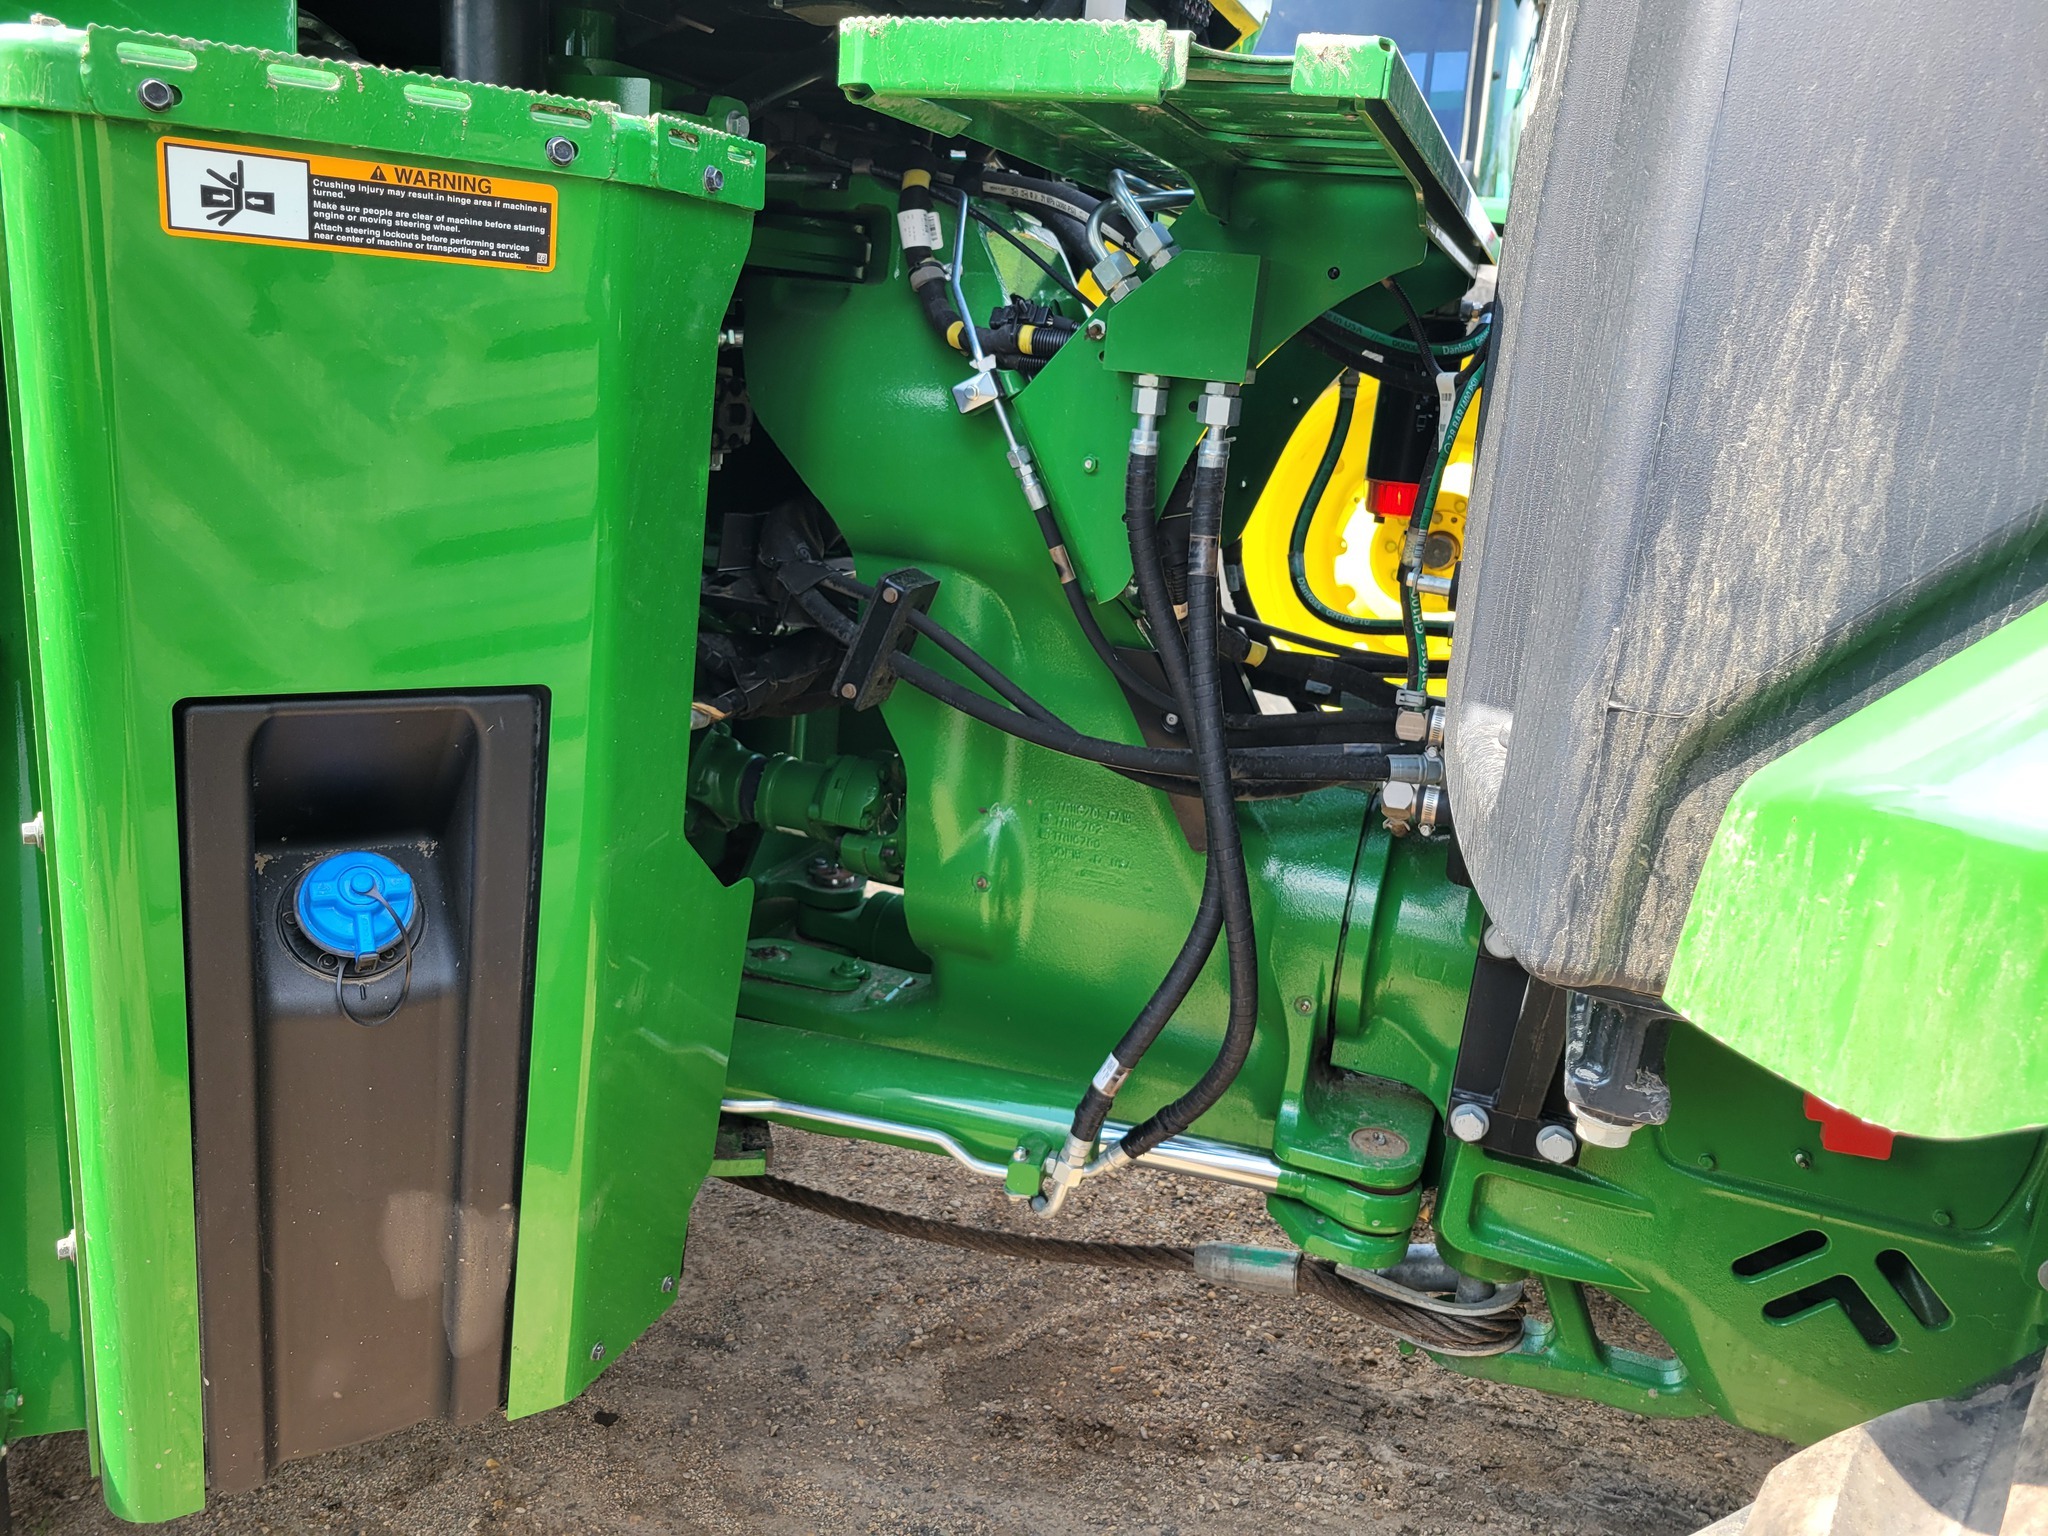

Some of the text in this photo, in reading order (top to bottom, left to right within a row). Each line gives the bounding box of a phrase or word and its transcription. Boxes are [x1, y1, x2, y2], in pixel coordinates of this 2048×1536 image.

[313, 188, 346, 199] turned.
[394, 167, 492, 194] WARNING
[313, 178, 547, 214] Crushing injury may result in hinge area if machine is
[313, 200, 546, 235] Make sure people are clear of machine before starting
[313, 210, 345, 220] engine
[359, 216, 393, 227] moving
[394, 219, 431, 231] steering
[433, 223, 461, 233] wheel.
[314, 222, 530, 252] Attach steering lockouts before performing services
[314, 232, 334, 240] near
[336, 234, 364, 244] center
[366, 236, 375, 245] of
[377, 238, 413, 249] machine
[426, 243, 477, 257] transporting
[498, 250, 521, 260] truck.
[1333, 315, 1342, 324] in
[1344, 320, 1363, 334] USA
[1442, 343, 1474, 355] Danfoss
[1452, 408, 1465, 429] BAR
[1447, 429, 1458, 442] 28
[1296, 576, 1322, 610] Danfoss
[1418, 643, 1428, 692] anfoss
